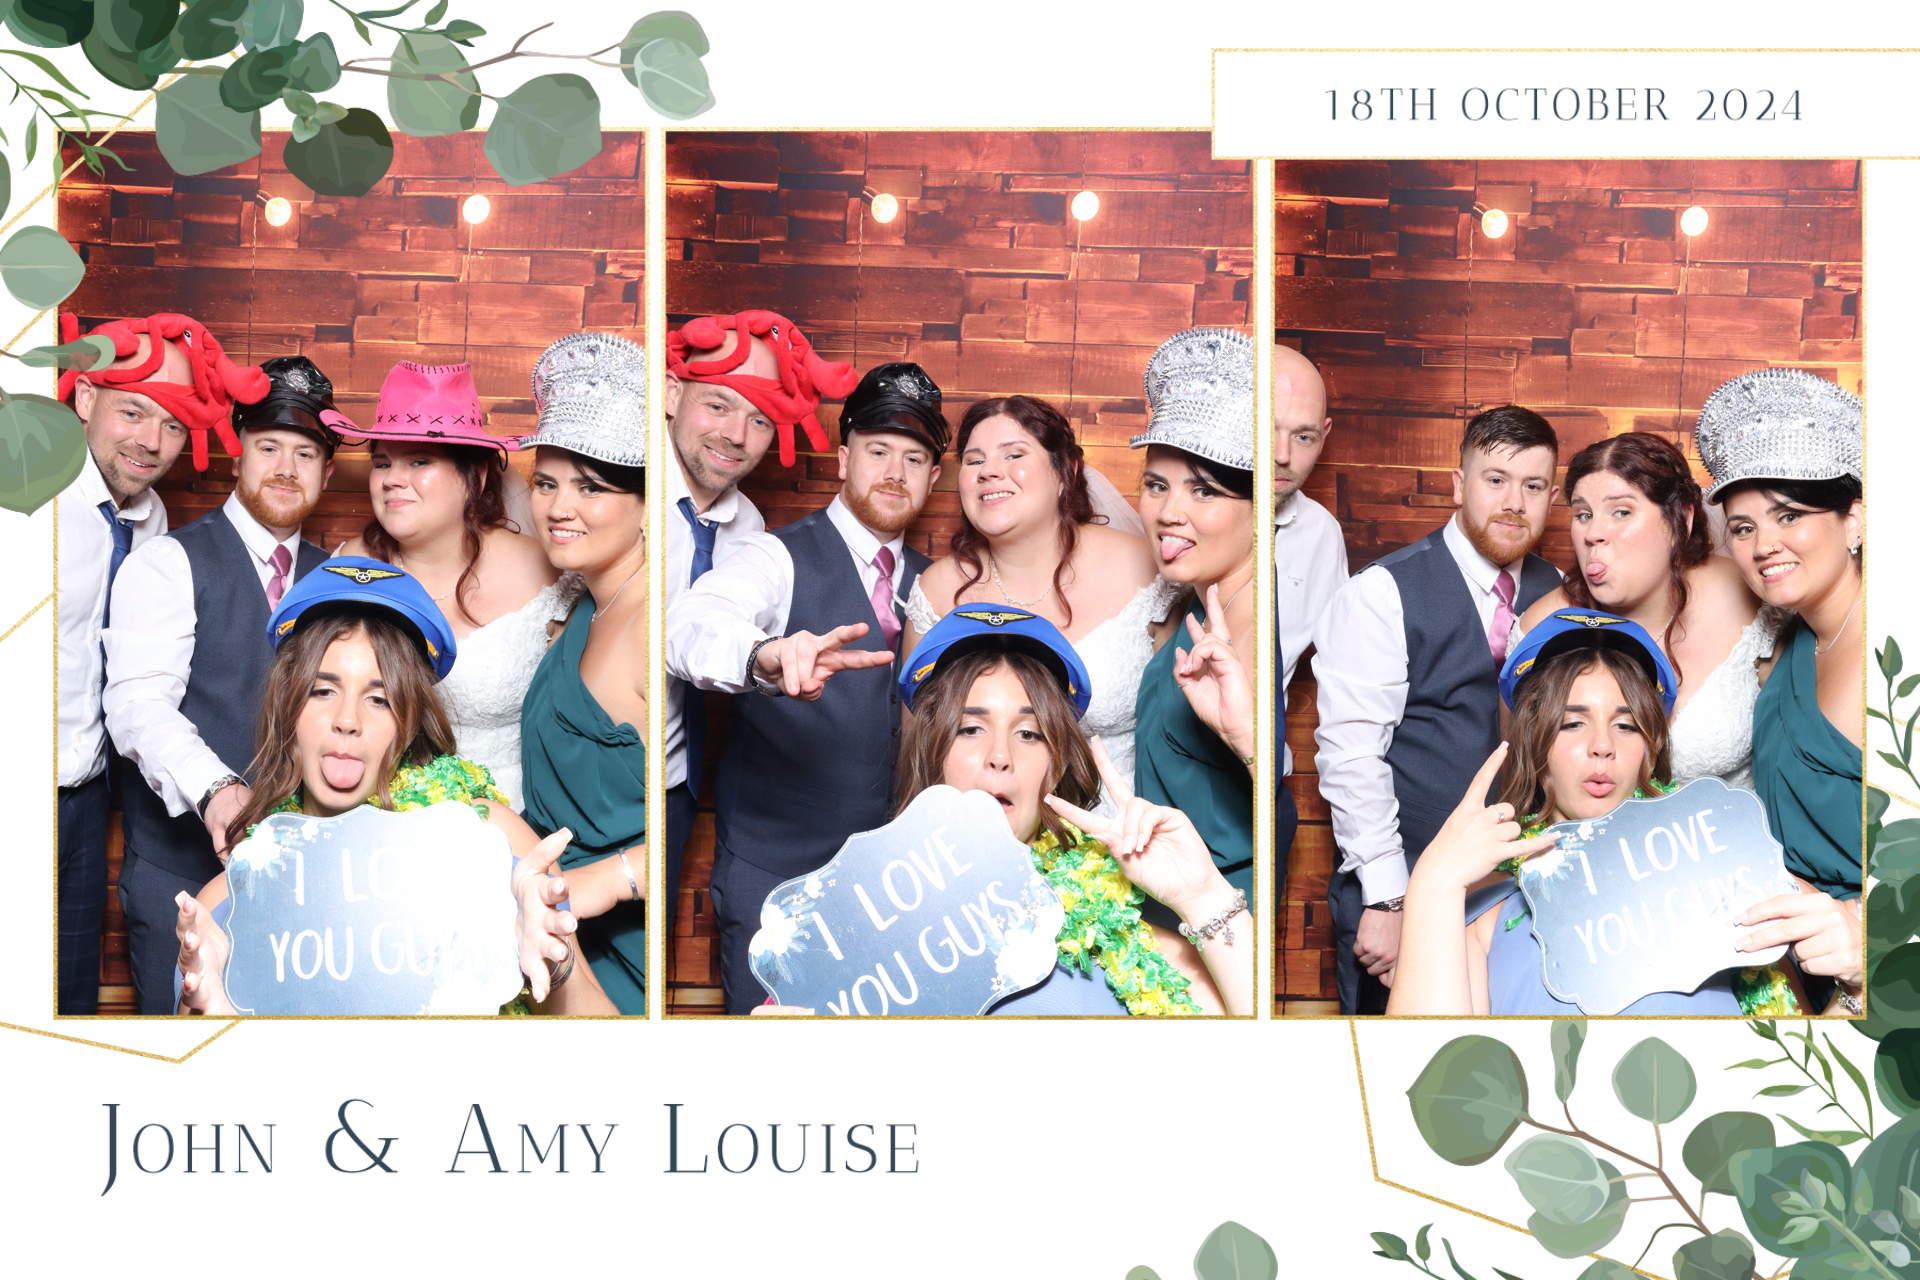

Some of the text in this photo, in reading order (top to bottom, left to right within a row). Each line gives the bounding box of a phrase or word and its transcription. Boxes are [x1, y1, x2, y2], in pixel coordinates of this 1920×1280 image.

[296, 850, 305, 906] I
[1579, 809, 1728, 895] I LOVE
[812, 825, 973, 960] I LOVE
[918, 881, 1024, 973] GUYS
[270, 926, 354, 982] YOU
[1574, 901, 1656, 965] YOU
